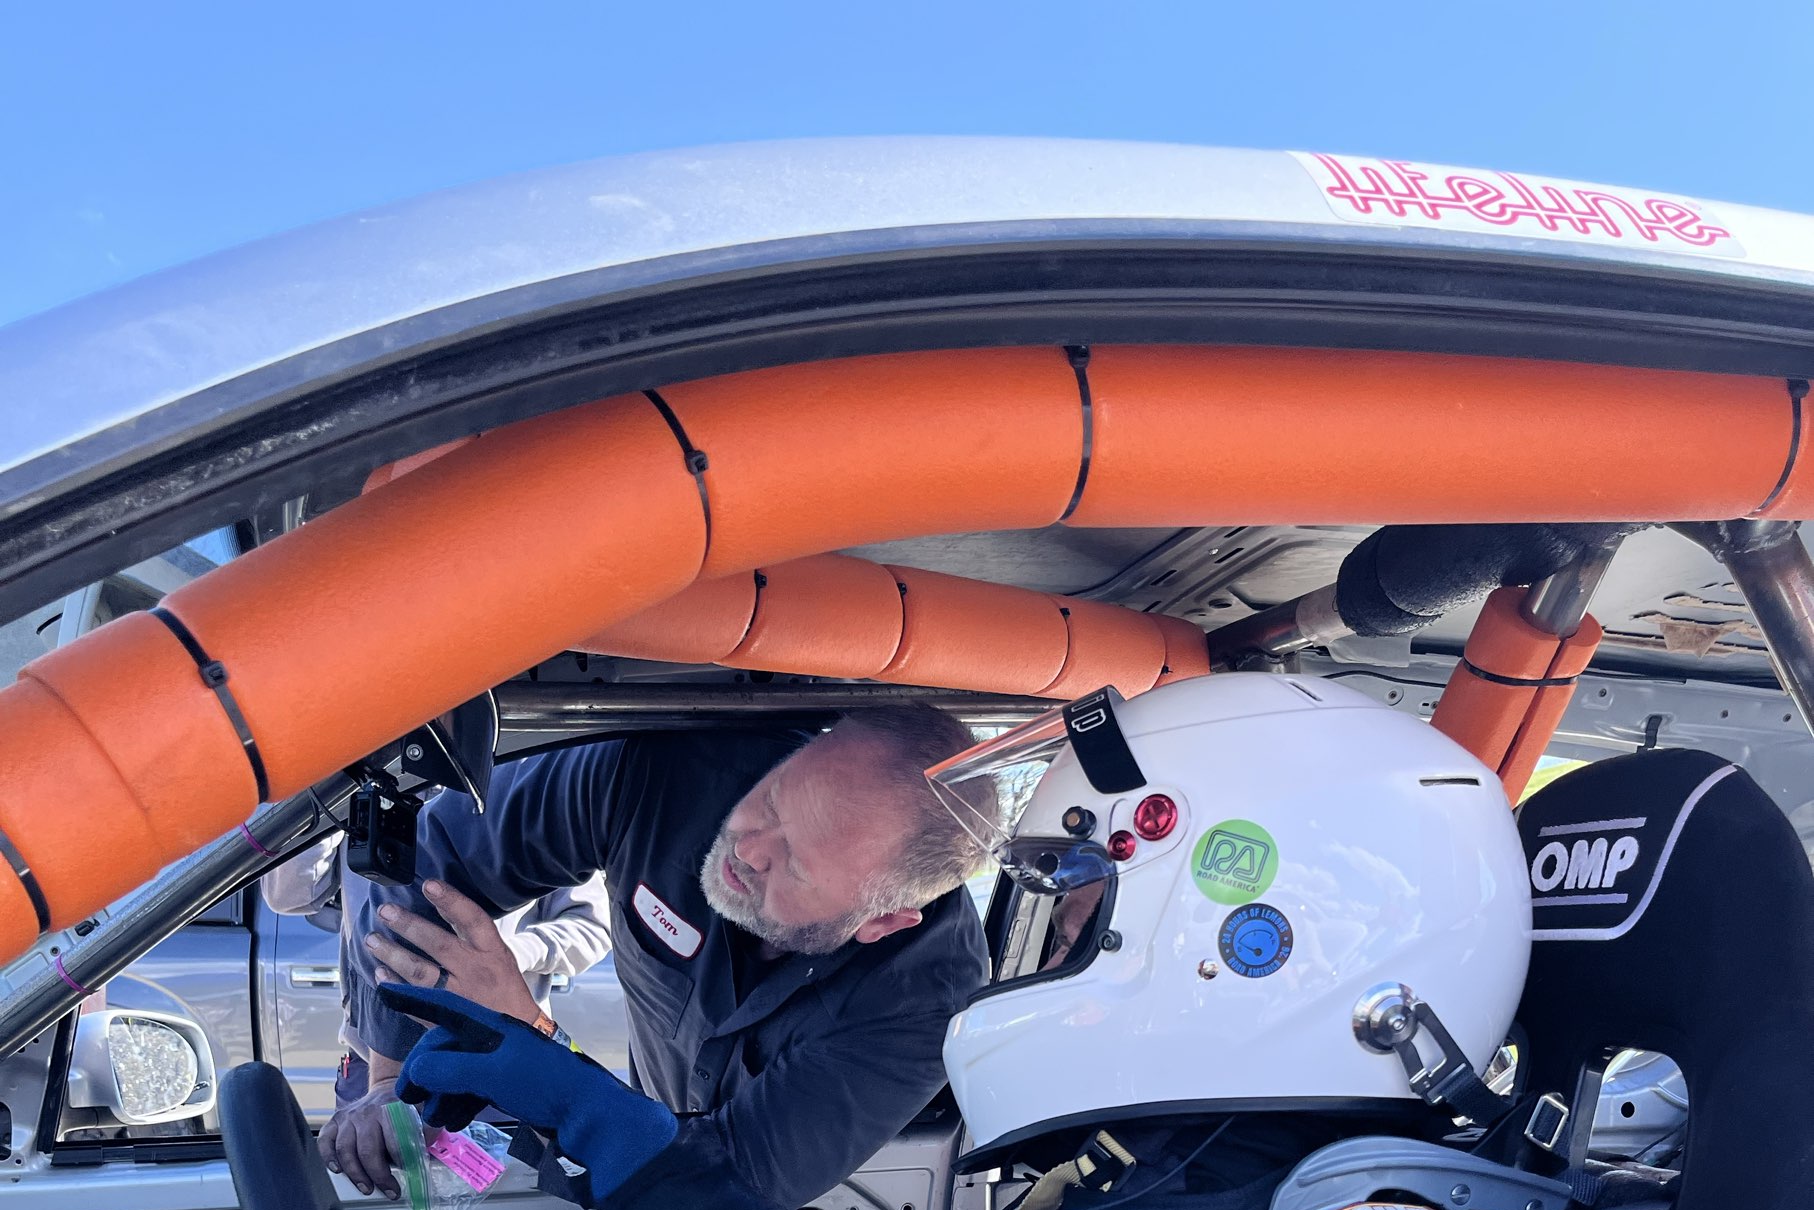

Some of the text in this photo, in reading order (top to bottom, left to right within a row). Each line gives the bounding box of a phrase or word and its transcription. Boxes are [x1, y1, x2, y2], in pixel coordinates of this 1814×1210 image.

[1196, 870, 1219, 882] ROAD
[1531, 836, 1640, 892] OMP
[651, 905, 679, 936] Tom
[1221, 907, 1289, 944] 24 HOURS OF LEMONS
[1226, 956, 1247, 974] ROAD
[1246, 959, 1281, 977] AMERICA
